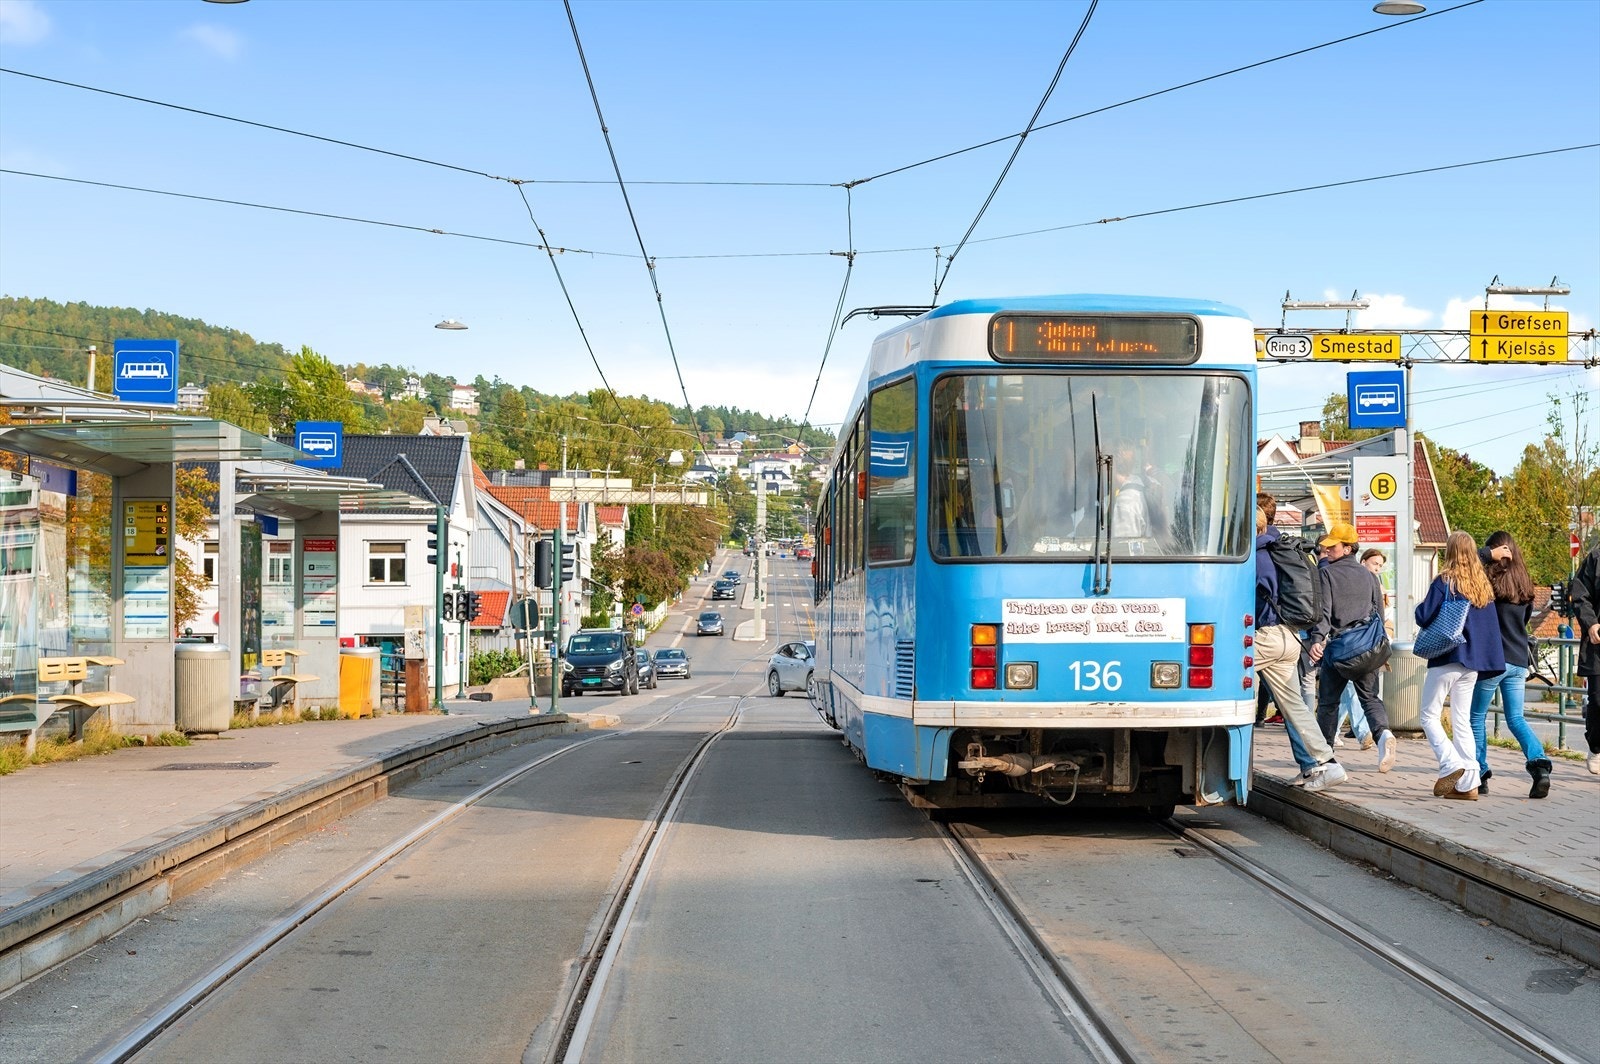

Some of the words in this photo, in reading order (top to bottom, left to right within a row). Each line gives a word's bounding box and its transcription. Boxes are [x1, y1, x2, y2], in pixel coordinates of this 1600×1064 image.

[1498, 314, 1561, 331] Grefsen
[1270, 341, 1296, 355] Ring
[1298, 340, 1307, 353] 3
[1320, 338, 1393, 354] Smestad
[1497, 340, 1556, 359] Kjelsås
[1377, 478, 1390, 495] B
[1006, 601, 1068, 616] Trikken
[1071, 604, 1088, 615] er
[1092, 602, 1118, 614] din
[1006, 621, 1041, 635] ikke
[1046, 620, 1091, 636] kræsj
[1096, 620, 1129, 633] med
[1134, 620, 1163, 633] den
[1068, 660, 1123, 692] 136
